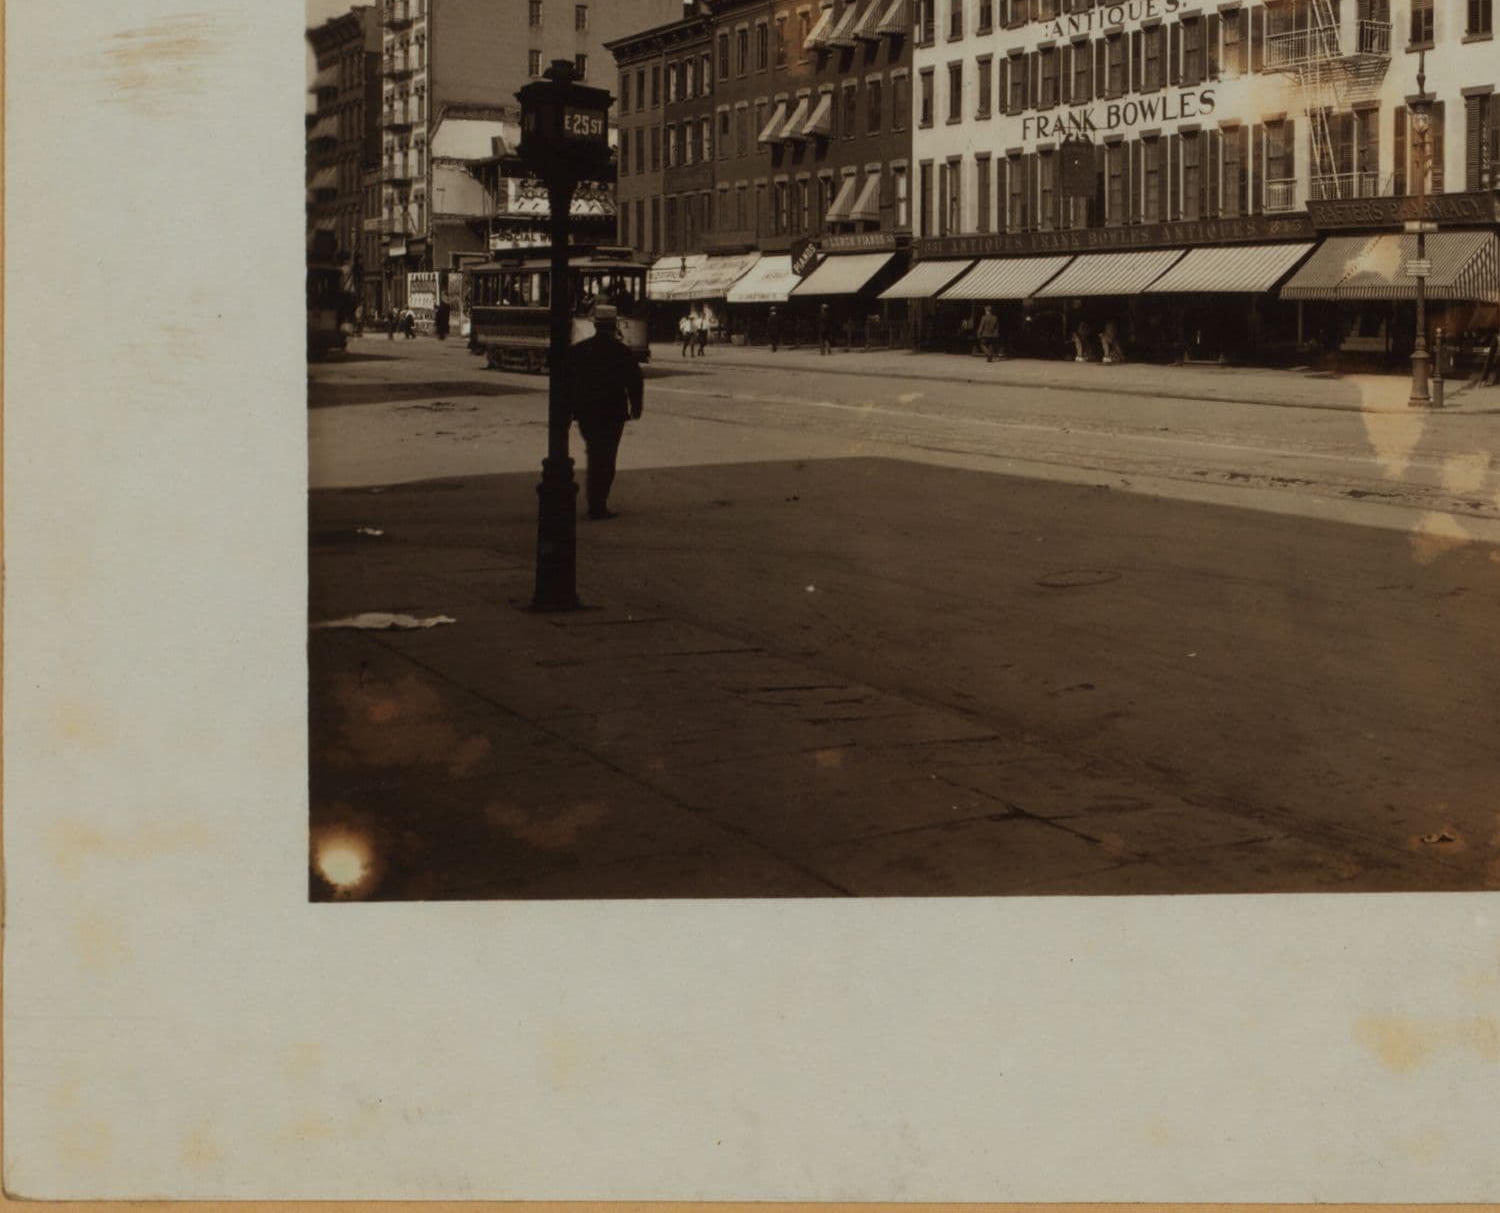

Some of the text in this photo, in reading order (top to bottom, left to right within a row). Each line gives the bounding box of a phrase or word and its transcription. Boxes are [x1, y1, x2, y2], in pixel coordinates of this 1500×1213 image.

[564, 113, 603, 136] E 25 ST
[1021, 89, 1217, 140] FRANK BOWLES
[1031, 232, 1080, 251] FRANK
[793, 243, 817, 274] PIANOS
